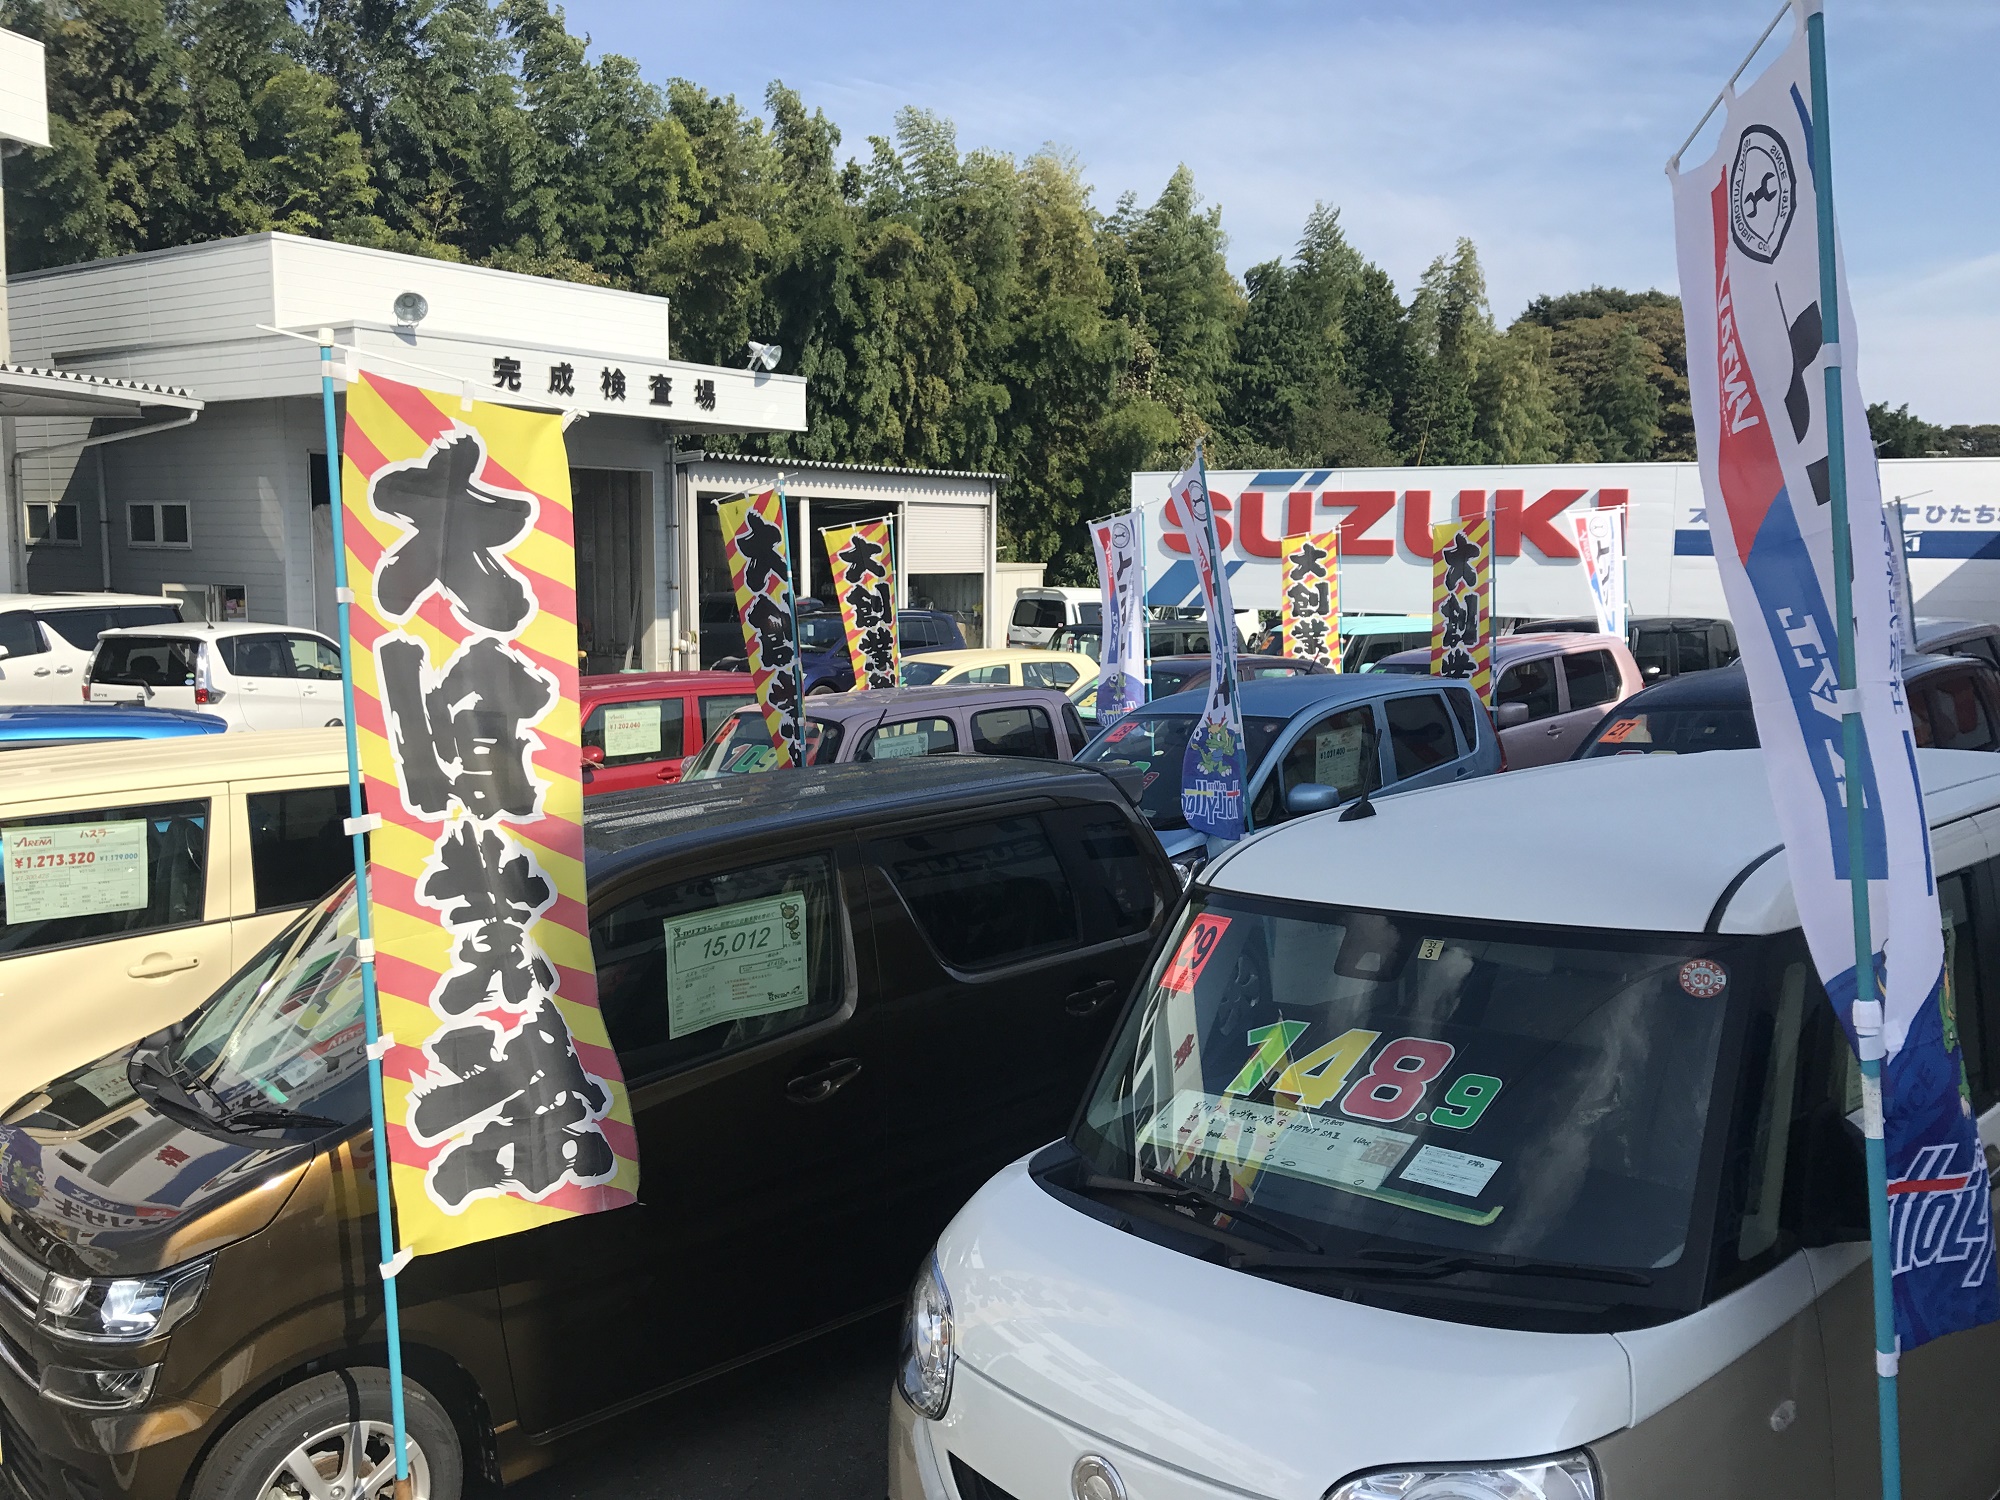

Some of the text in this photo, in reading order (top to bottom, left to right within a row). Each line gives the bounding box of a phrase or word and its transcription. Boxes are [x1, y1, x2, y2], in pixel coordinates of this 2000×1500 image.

[492, 356, 718, 412] 完成検査場
[1608, 723, 1636, 736] 27
[80, 829, 115, 838] ハスラー
[14, 837, 53, 848] ARENA
[703, 926, 772, 960] 15,012
[1174, 923, 1219, 970] 29
[1425, 949, 1433, 958] 3
[1694, 973, 1710, 985] 30
[1224, 1019, 1503, 1129] 148.9
